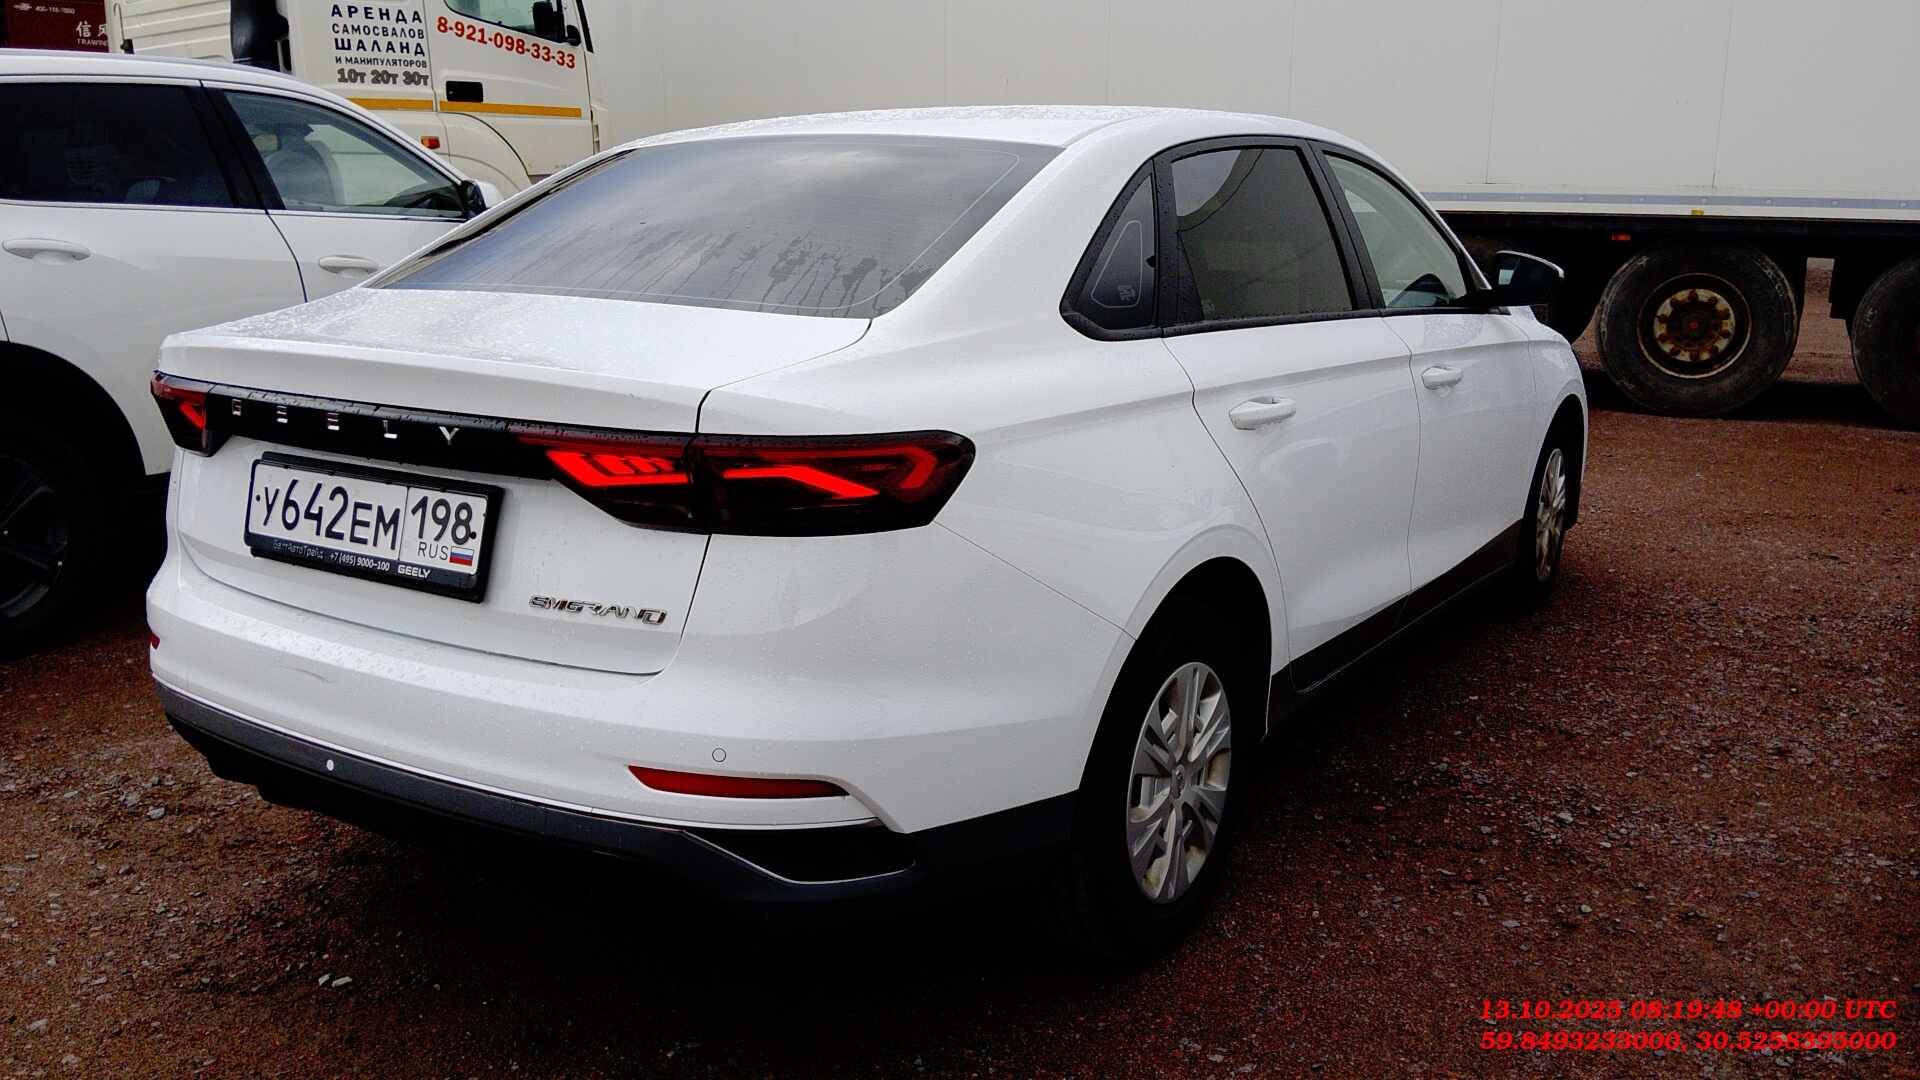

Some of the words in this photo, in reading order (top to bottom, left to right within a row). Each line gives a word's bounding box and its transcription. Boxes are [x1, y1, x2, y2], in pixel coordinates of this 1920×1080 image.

[331, 4, 422, 24] АРЕНДА
[332, 23, 425, 39] САМОСВАЛОВ
[437, 16, 576, 69] 8-921-098-33-33
[335, 38, 425, 57] ШАЛАНД
[335, 56, 342, 64] И
[345, 56, 427, 68] МАНИПУЛЯТОРОВ
[232, 398, 460, 446] GEELY
[411, 496, 472, 545] 198
[418, 541, 449, 561] RUS
[329, 552, 338, 561] +7
[357, 556, 390, 571] 9000-100
[398, 564, 431, 578] GEELY
[529, 595, 667, 625] EMGRAND
